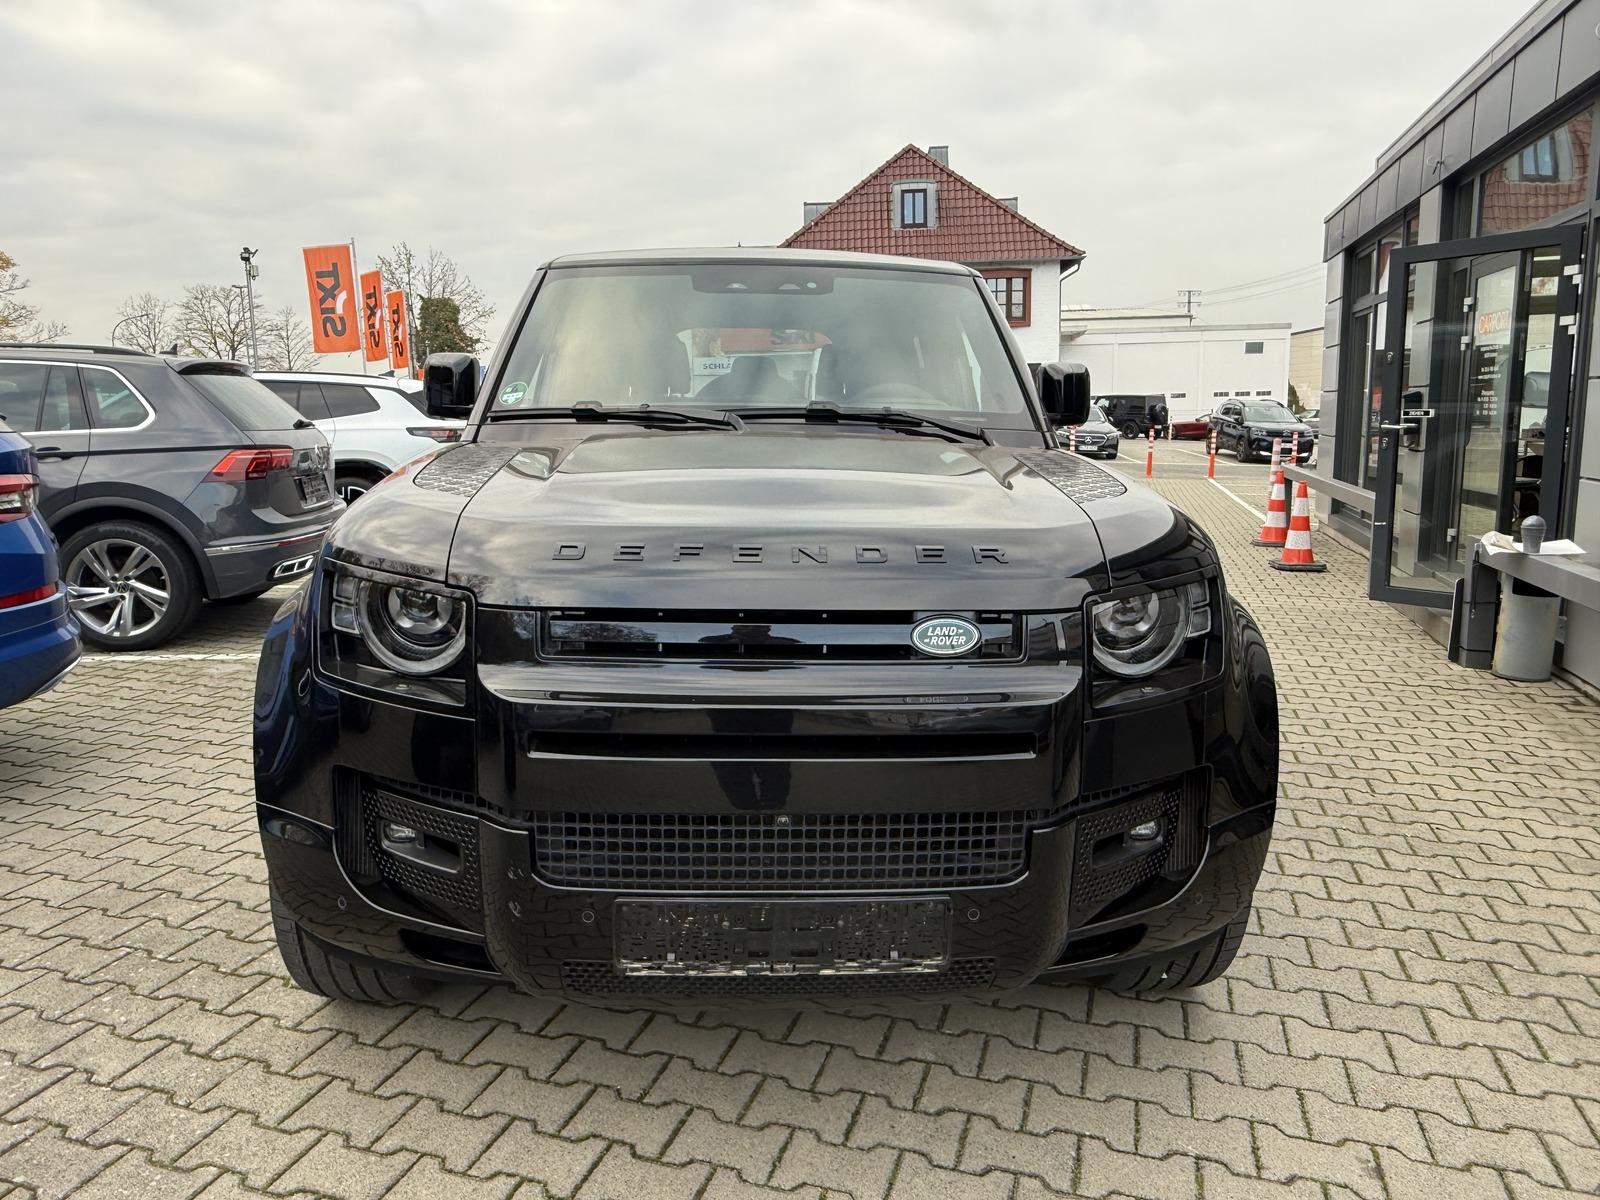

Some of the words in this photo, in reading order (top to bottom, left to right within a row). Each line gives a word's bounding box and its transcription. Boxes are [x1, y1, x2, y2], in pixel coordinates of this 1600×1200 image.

[551, 541, 1010, 564] DEFENDER
[927, 626, 957, 636] LAND
[930, 636, 967, 646] ROVER
